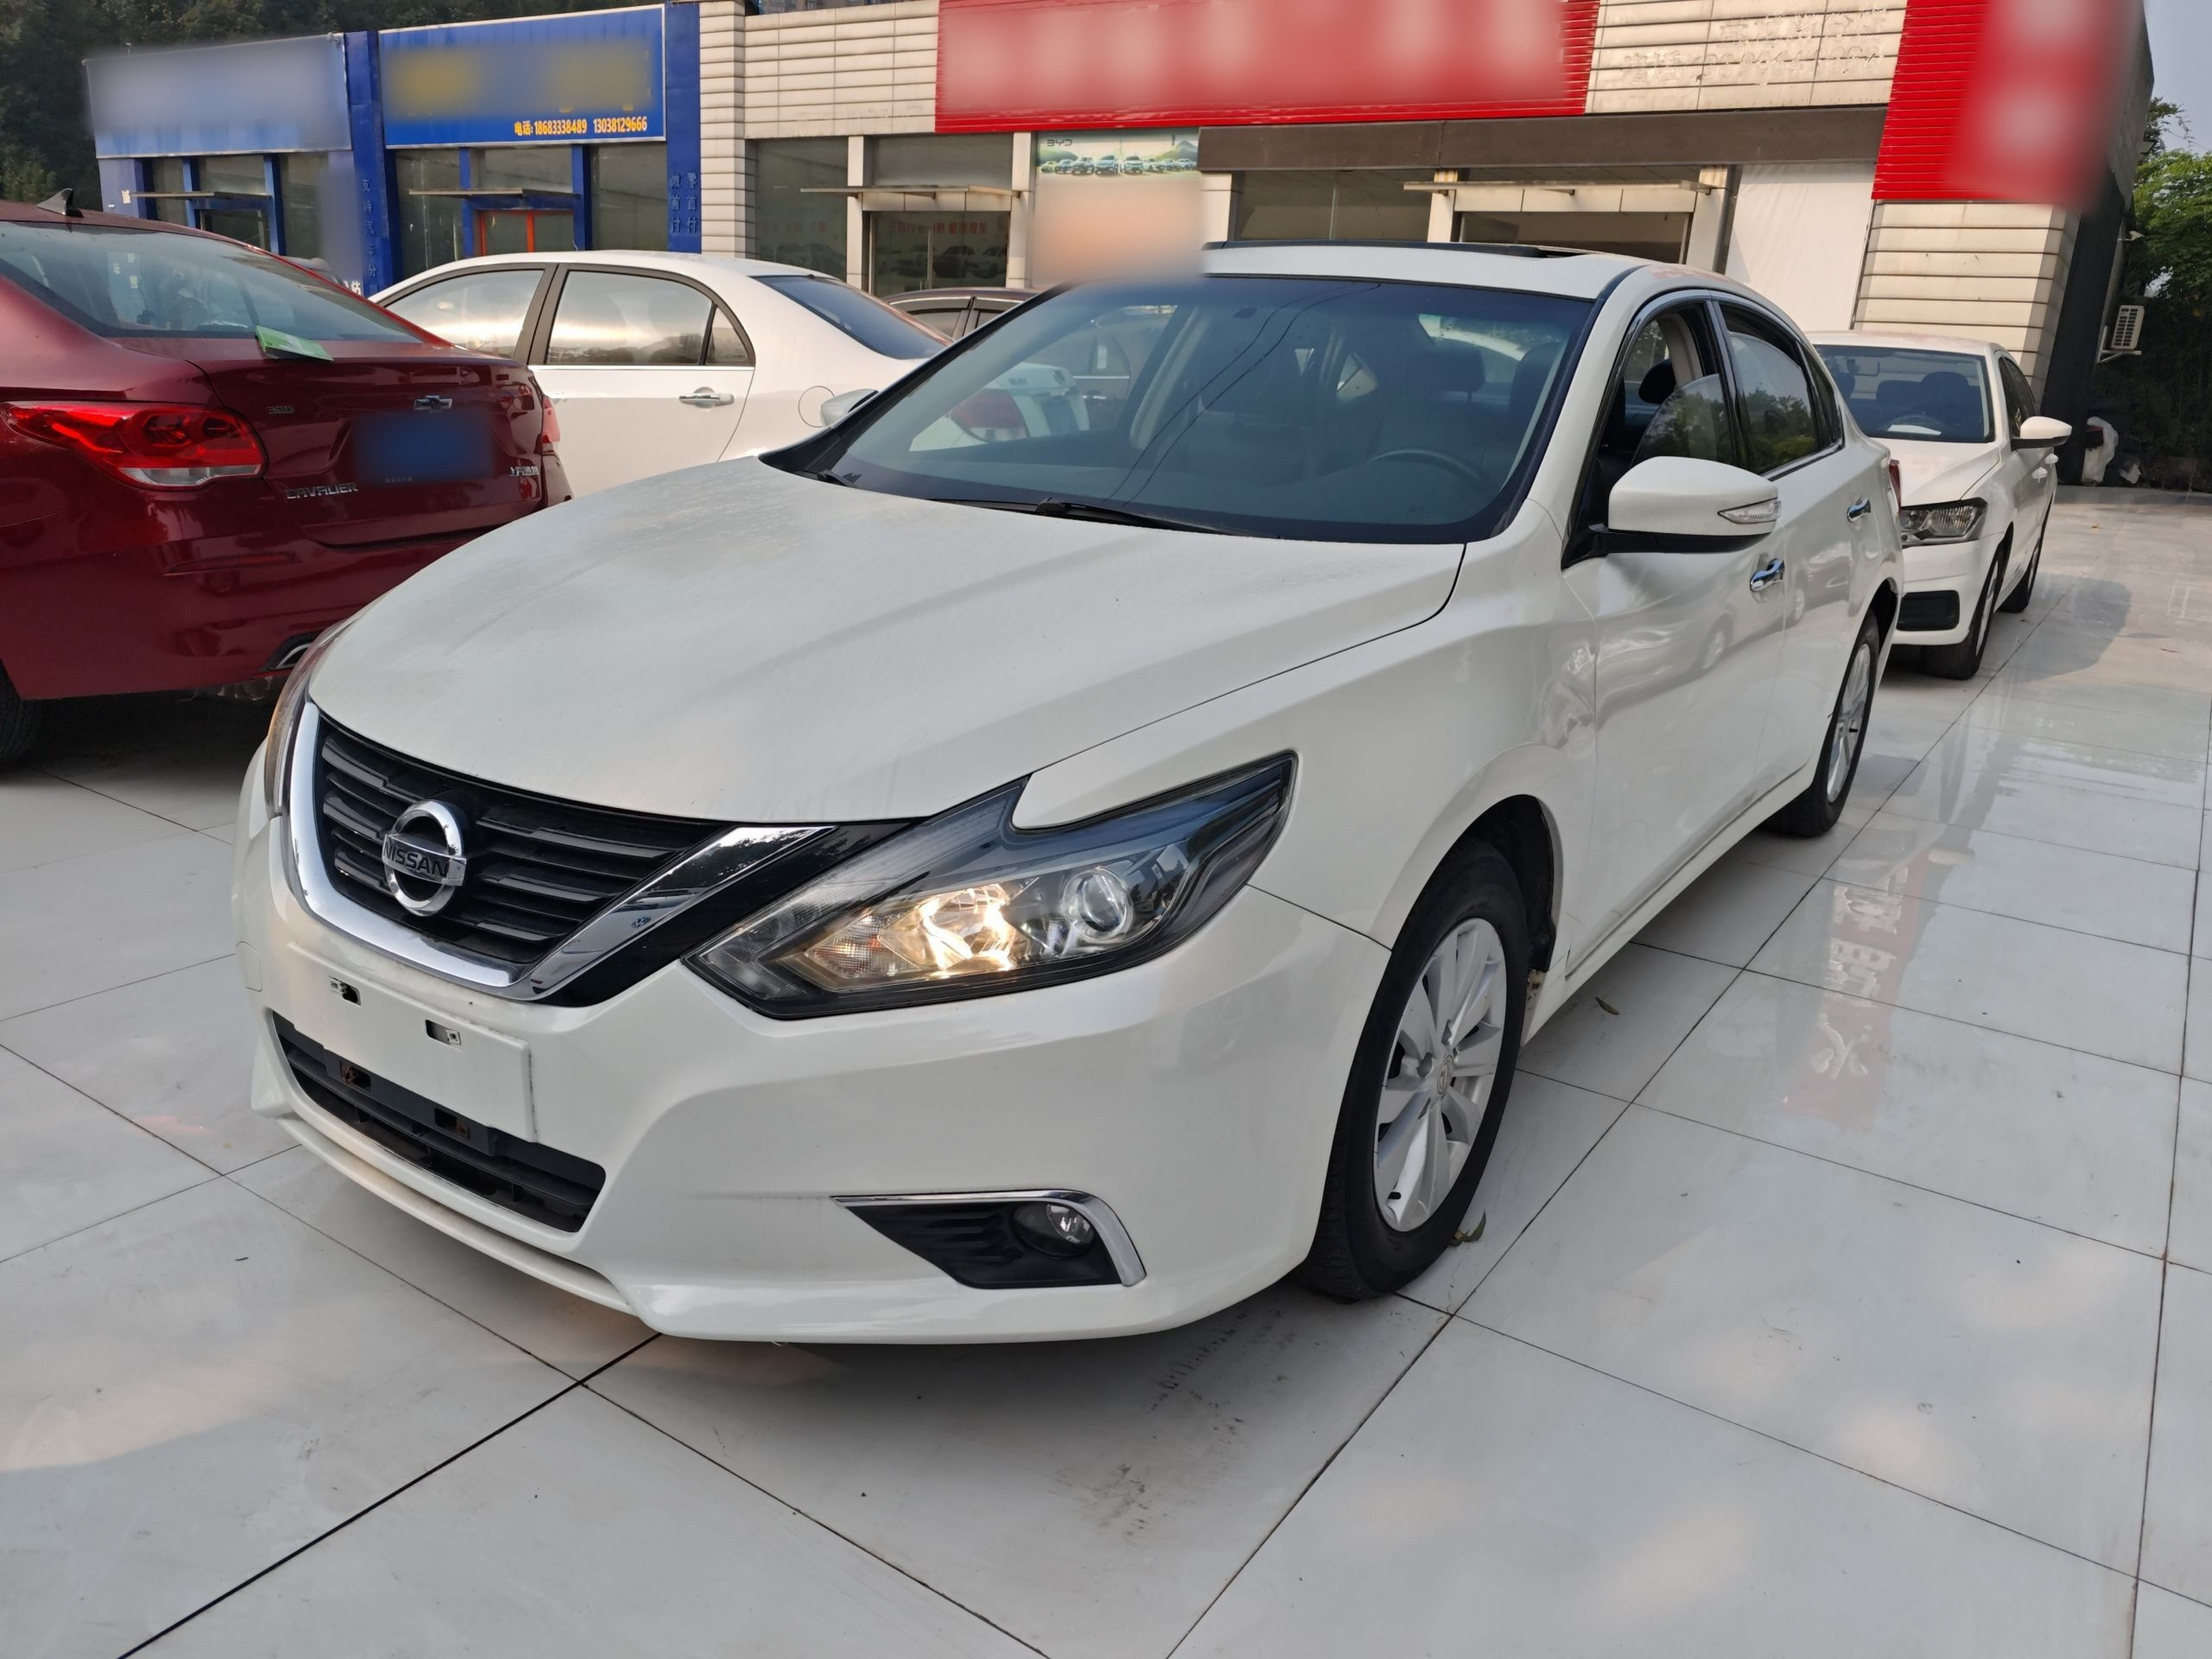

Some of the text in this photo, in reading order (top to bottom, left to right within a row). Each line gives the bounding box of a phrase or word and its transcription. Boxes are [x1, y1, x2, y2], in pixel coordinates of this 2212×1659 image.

[593, 116, 647, 134] 13038129666
[286, 483, 358, 499] CAVALIER
[385, 838, 449, 878] NISSAN
